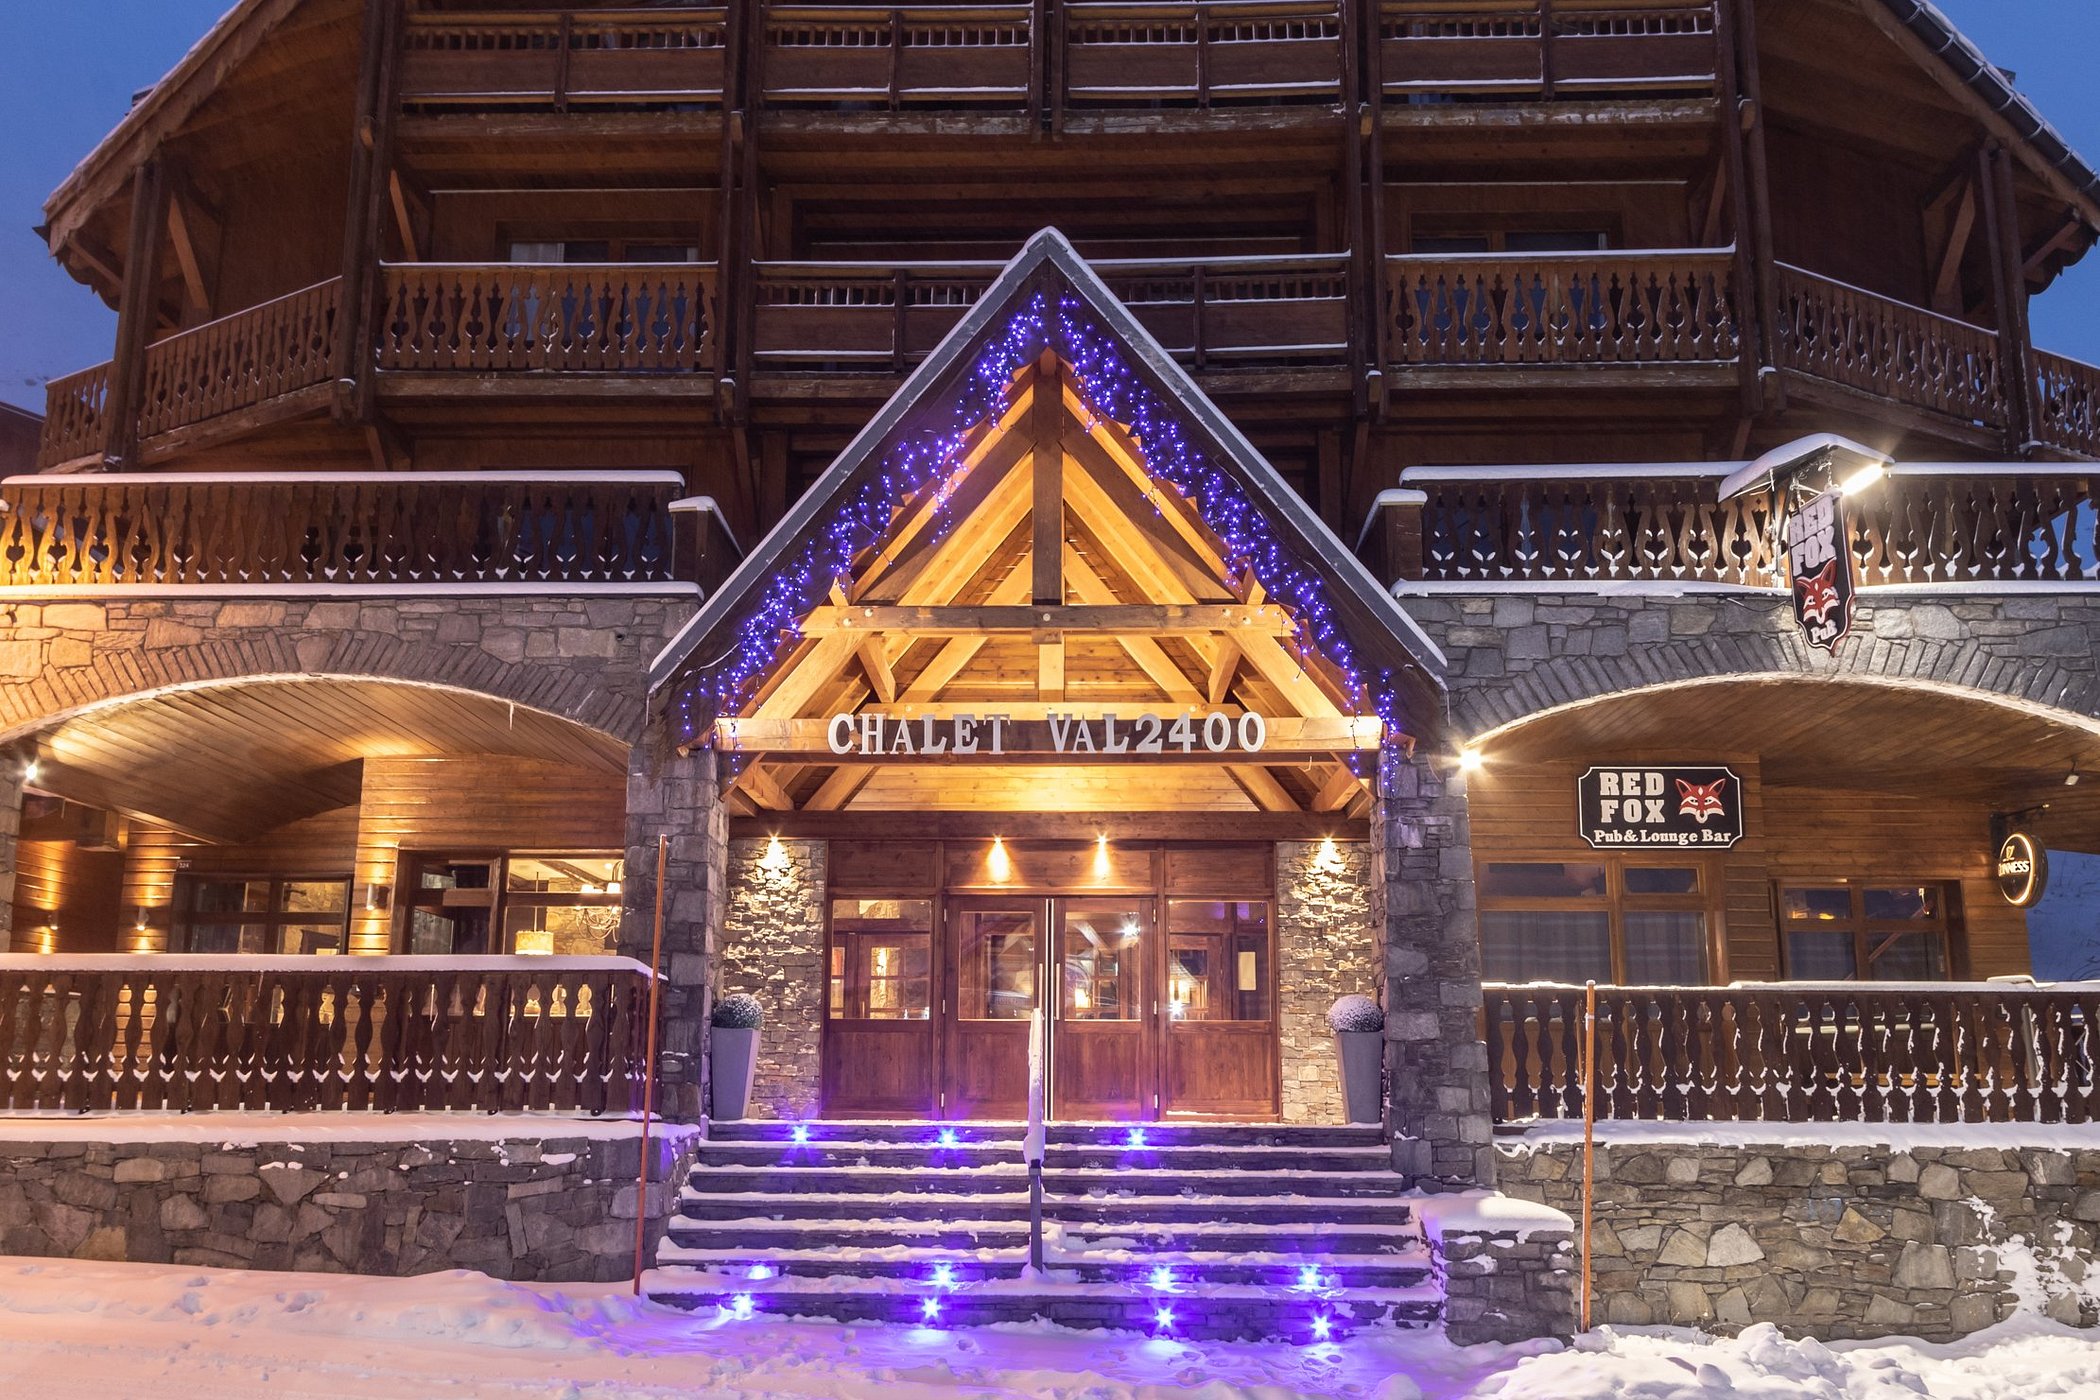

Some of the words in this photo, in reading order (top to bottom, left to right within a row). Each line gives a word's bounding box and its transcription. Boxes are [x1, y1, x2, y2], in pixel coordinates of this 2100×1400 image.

[1789, 496, 1834, 547] RED
[1791, 525, 1836, 577] FOX
[827, 713, 1010, 755] CHALET
[1599, 772, 1665, 796] RED
[1600, 799, 1665, 823] FOX
[1701, 829, 1731, 842] Bar
